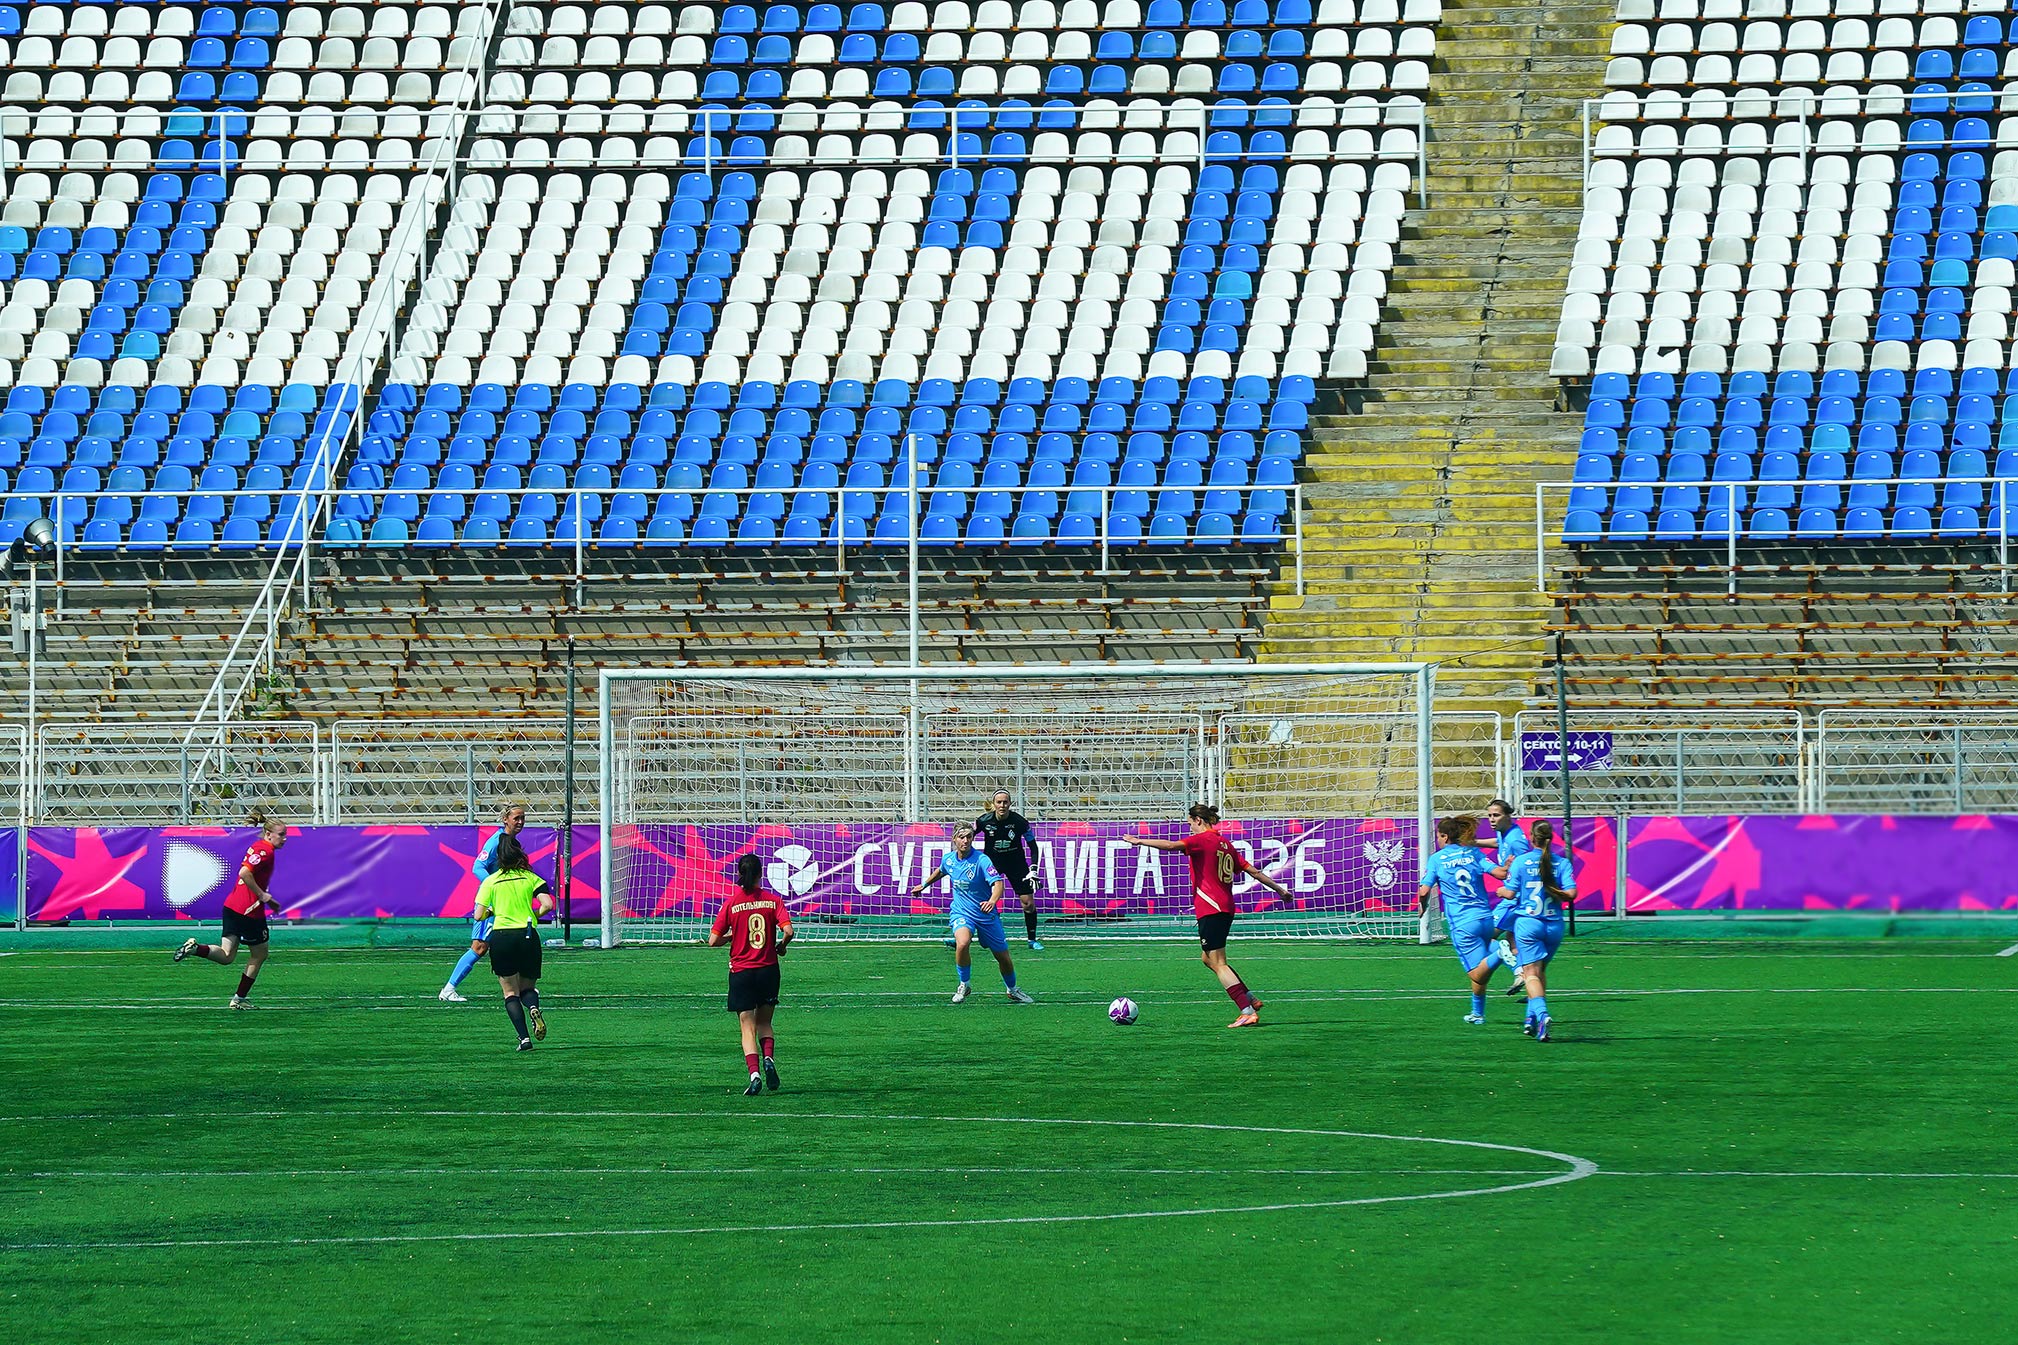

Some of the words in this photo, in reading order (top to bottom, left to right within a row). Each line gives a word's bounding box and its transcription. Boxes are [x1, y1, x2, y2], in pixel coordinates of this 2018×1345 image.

[1574, 740, 1605, 750] 10-11
[854, 840, 1165, 895] СУПЛИГА
[1216, 849, 1235, 884] 19
[748, 913, 766, 950] 8
